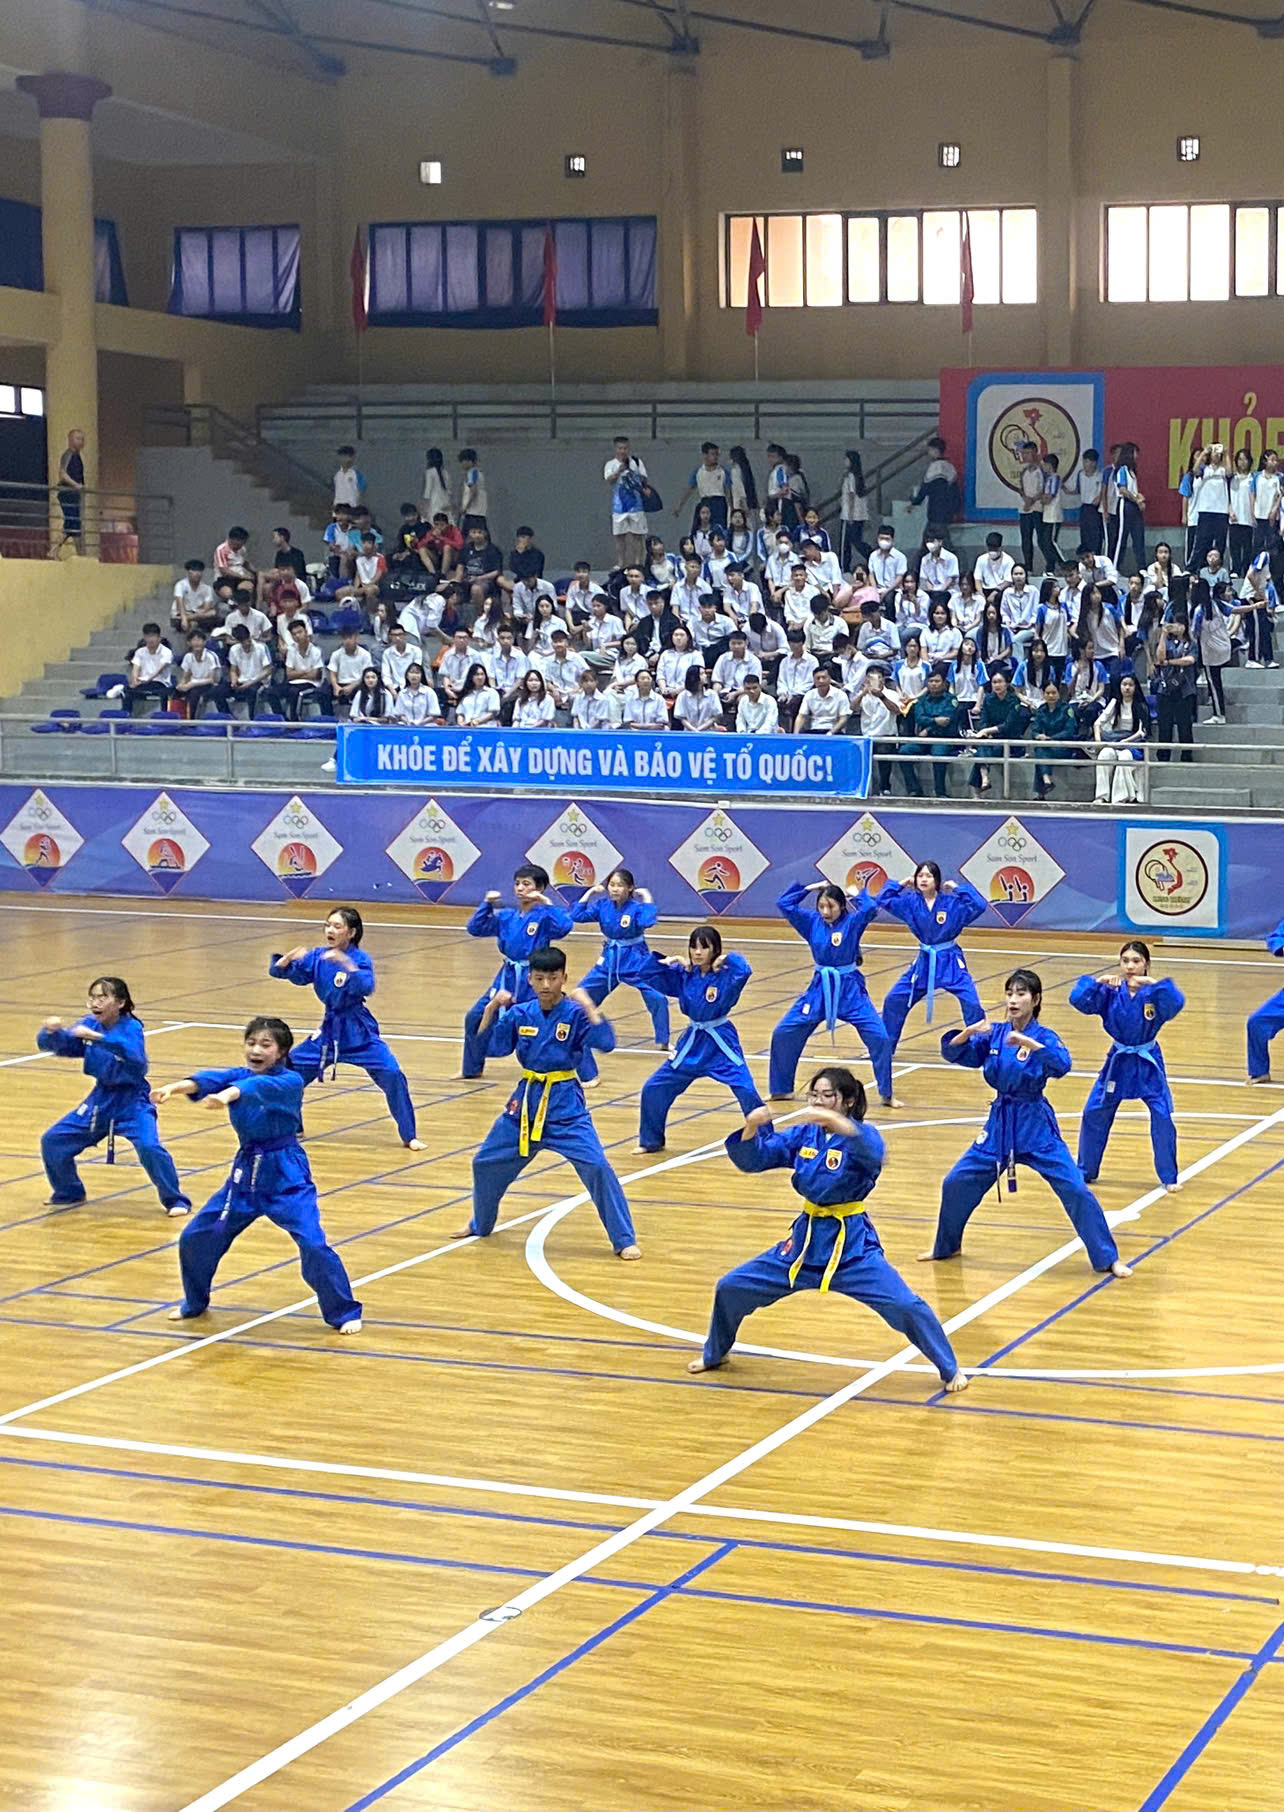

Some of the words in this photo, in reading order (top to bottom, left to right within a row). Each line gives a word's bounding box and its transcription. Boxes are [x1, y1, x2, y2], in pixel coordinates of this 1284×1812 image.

[377, 736, 437, 771] KHỎE
[442, 735, 473, 772] ĐỂ
[477, 741, 523, 774] XÂY
[528, 745, 593, 780] DỰNG
[598, 744, 629, 776] VÀ
[634, 742, 682, 778] BẢO
[688, 747, 717, 785] VỆ
[723, 743, 754, 780] TỔ
[759, 745, 834, 784] QUỐC!
